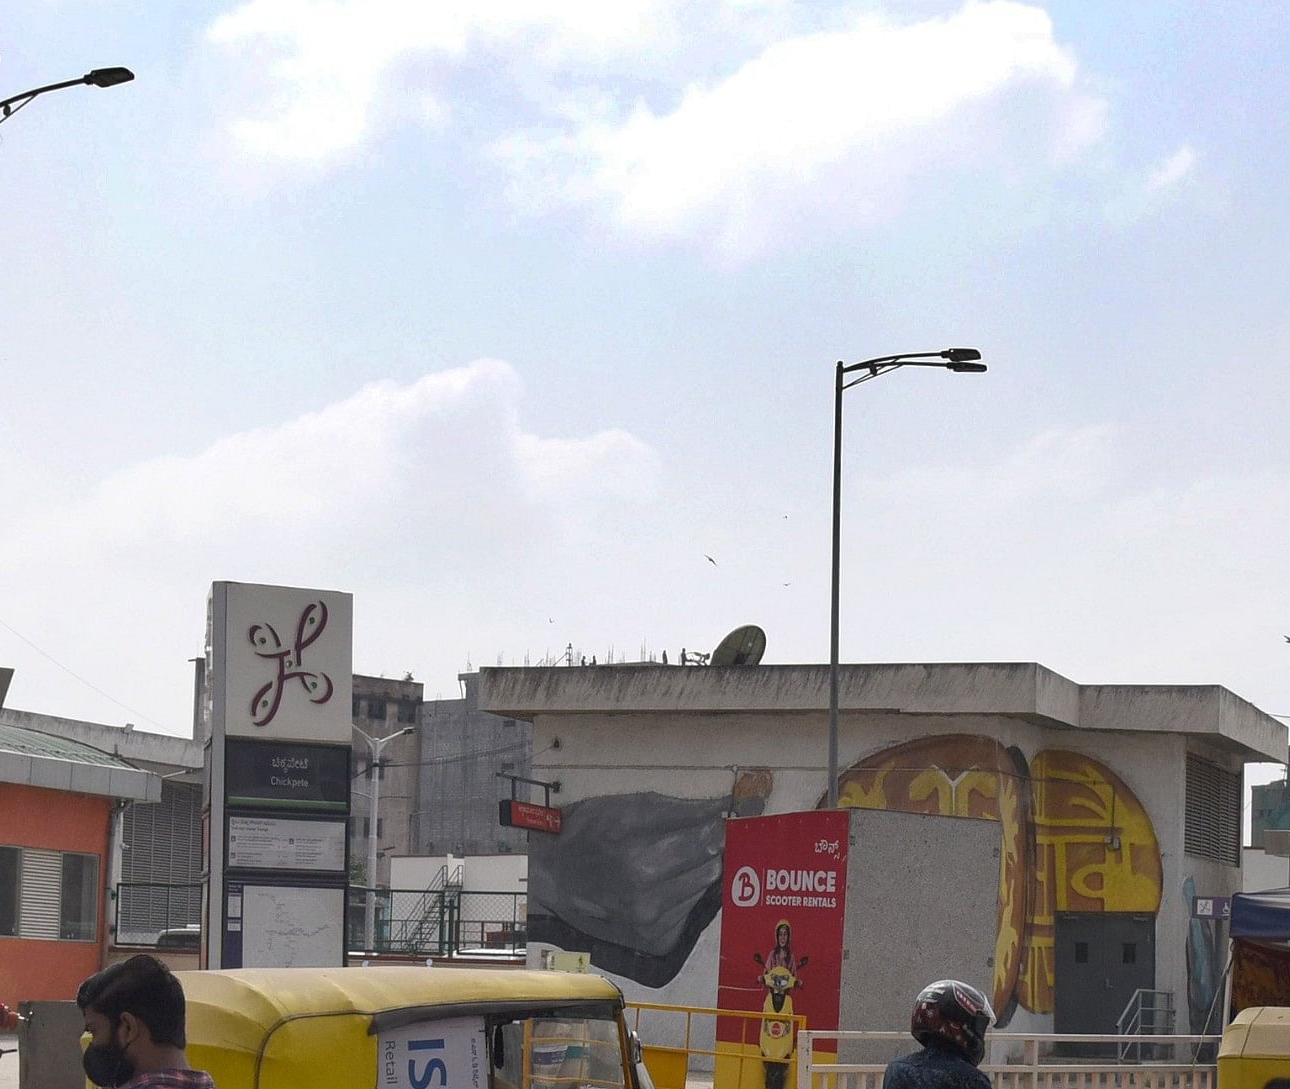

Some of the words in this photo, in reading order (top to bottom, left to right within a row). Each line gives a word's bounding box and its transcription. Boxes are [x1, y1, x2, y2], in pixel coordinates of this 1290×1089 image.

[270, 776, 309, 788] Chickpete
[766, 869, 837, 893] BOUNCE
[765, 895, 802, 907] SCOOTER
[803, 896, 837, 908] RENTALS
[385, 1040, 398, 1084] Retail
